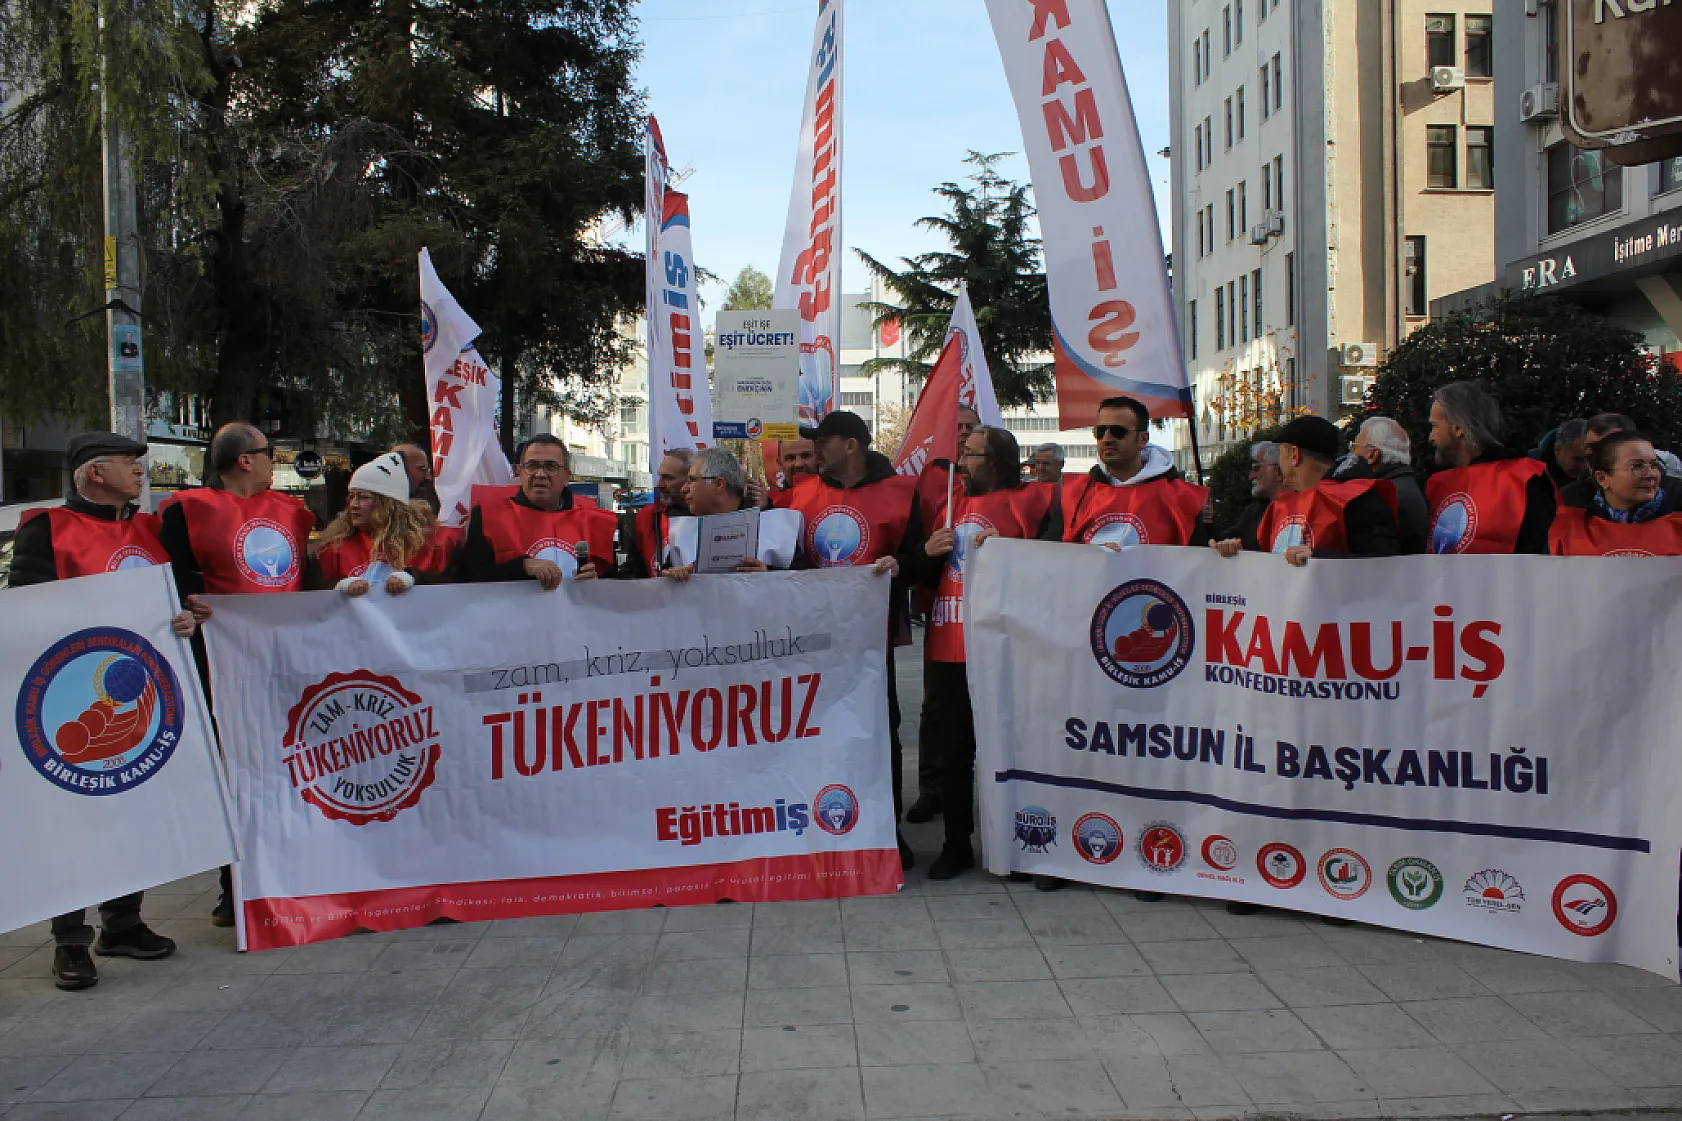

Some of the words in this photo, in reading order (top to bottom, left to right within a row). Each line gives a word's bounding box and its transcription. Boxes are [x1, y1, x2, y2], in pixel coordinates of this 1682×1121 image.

[1522, 255, 1577, 290] ERA
[1614, 232, 1653, 264] İşitme
[719, 330, 745, 350] EŞİT
[746, 329, 794, 346] ÜCRET!
[743, 318, 758, 331] EŞİT
[759, 318, 771, 331] İŞE
[491, 659, 569, 691] zam,
[584, 645, 651, 678] kriz,
[667, 625, 805, 681] yoksulluk
[1205, 604, 1505, 699] KAMU-İŞ
[1205, 664, 1400, 700] KONFEDERASYONU
[282, 705, 441, 788] TÜKENİYORUZ
[482, 673, 822, 781] TÜKENİYORUZ
[43, 757, 117, 791] BİRLEŞİK
[120, 729, 176, 785] KAMU-İŞ
[332, 753, 417, 802] YOKSULLUK
[1065, 716, 1225, 766] SAMSUN
[1233, 723, 1266, 774] İL
[1276, 740, 1549, 795] BAŞKANLIĞI
